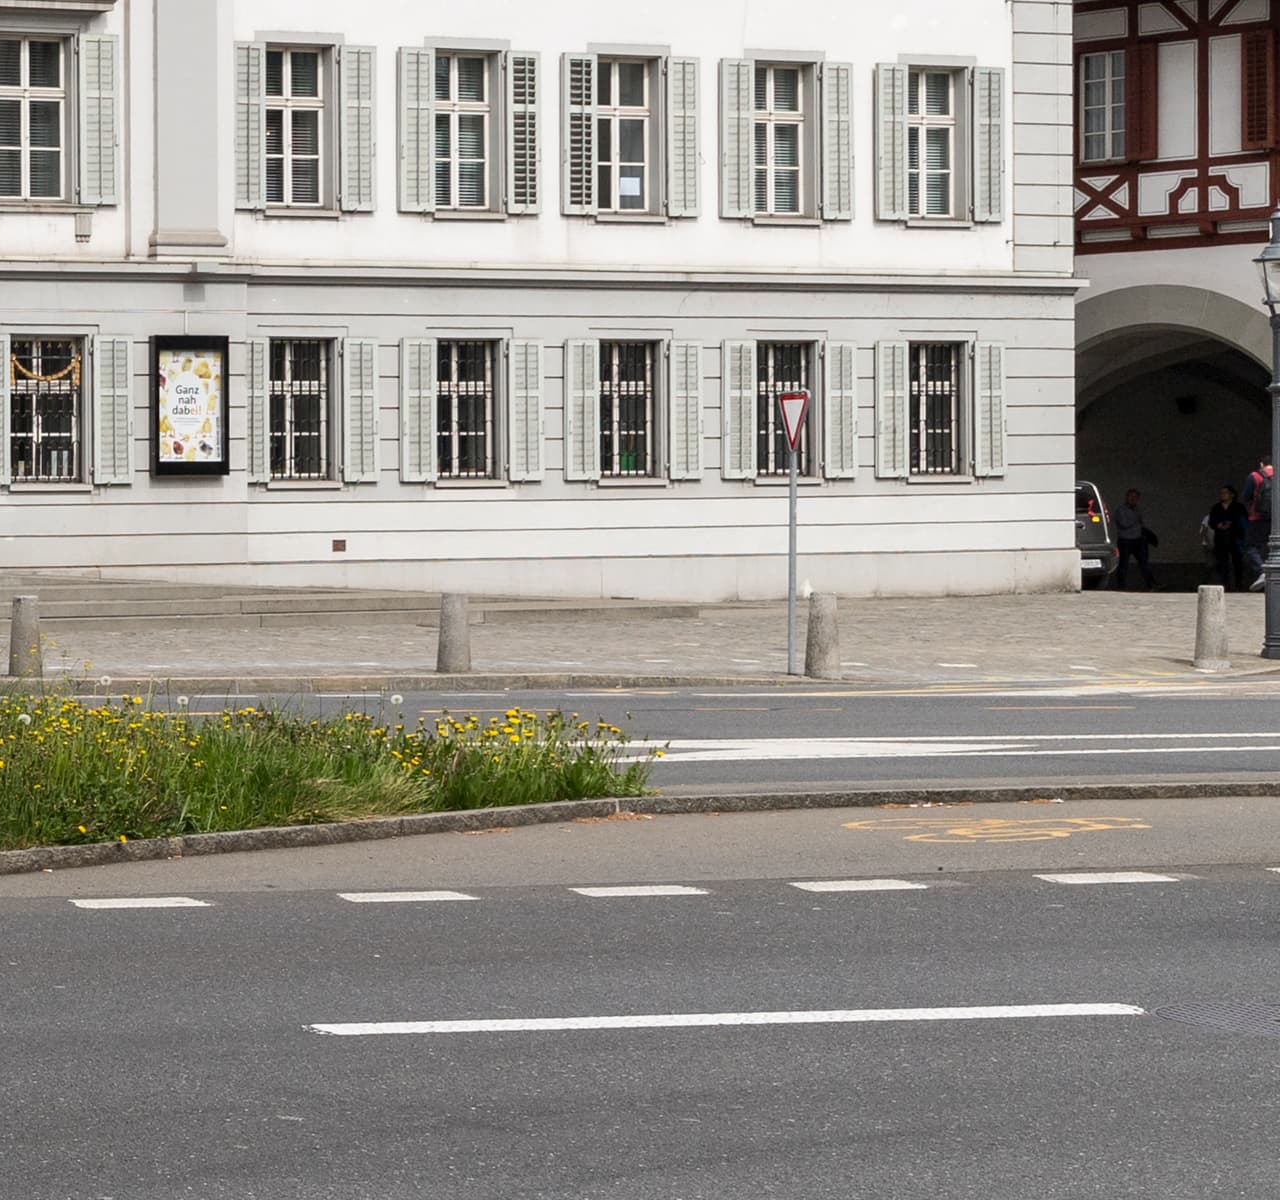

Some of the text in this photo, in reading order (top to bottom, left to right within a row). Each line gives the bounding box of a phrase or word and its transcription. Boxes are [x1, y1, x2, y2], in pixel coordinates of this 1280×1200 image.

[175, 385, 200, 395] Ganz
[178, 396, 197, 405] nah
[172, 406, 202, 415] dabei!
